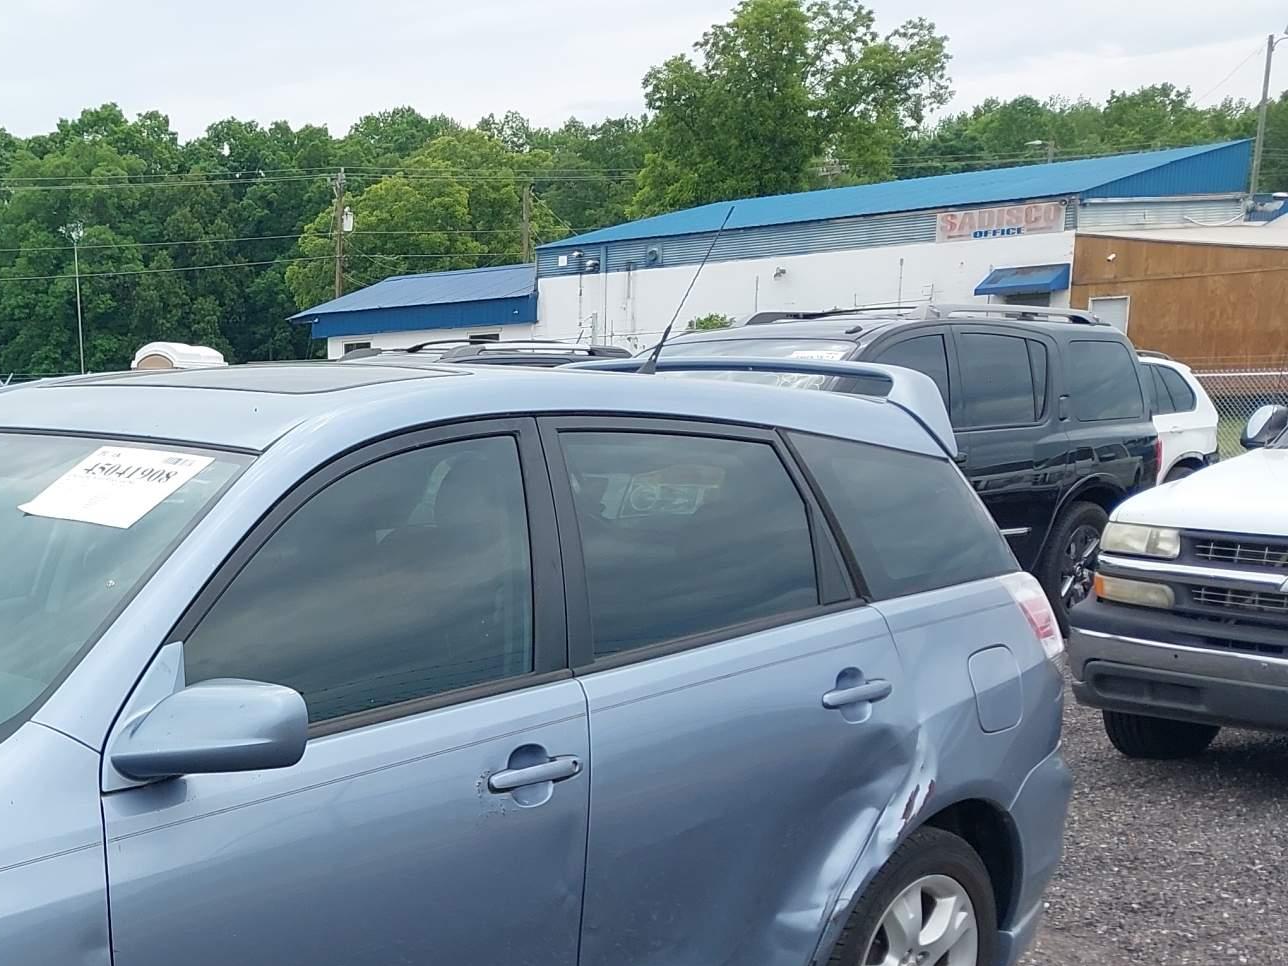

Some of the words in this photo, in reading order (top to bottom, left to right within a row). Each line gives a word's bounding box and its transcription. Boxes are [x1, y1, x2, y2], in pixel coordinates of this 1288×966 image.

[940, 204, 1062, 233] SADISCO
[972, 226, 1025, 239] OFFICE
[83, 462, 178, 484] 45041908
